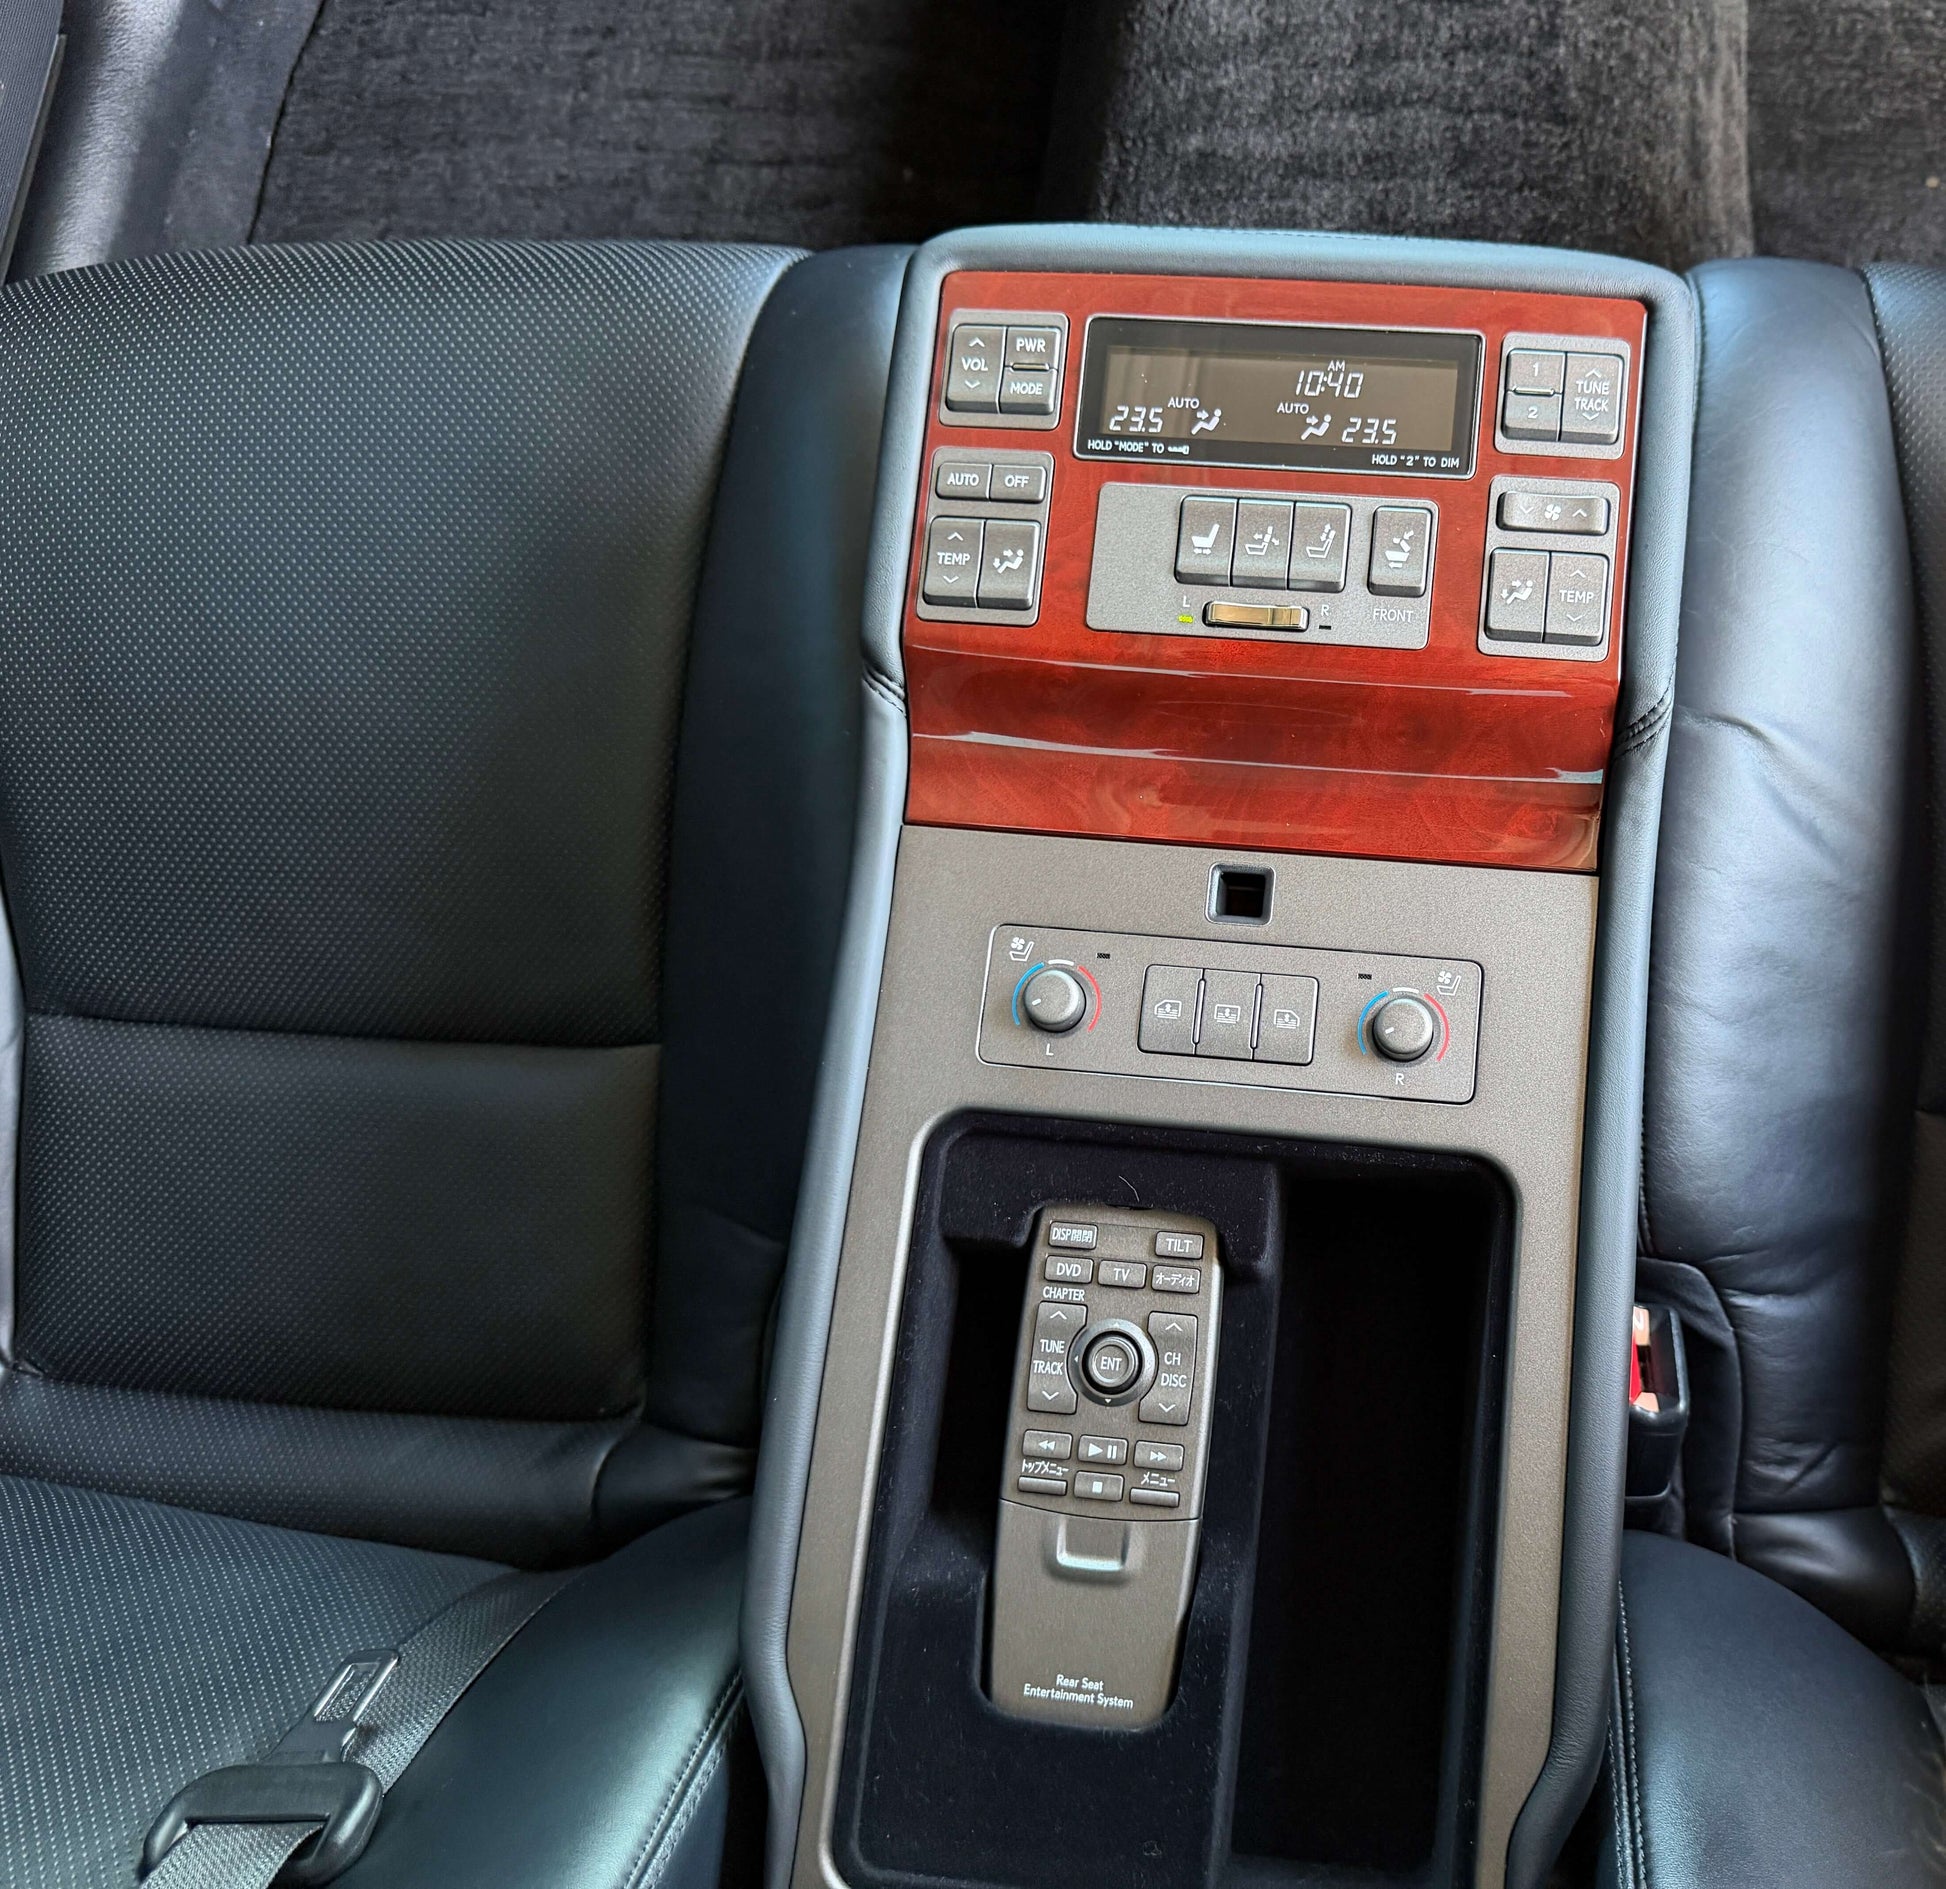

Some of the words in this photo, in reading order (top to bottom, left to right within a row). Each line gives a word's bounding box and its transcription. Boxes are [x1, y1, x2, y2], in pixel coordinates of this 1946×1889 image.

[1016, 338, 1046, 353] PWR
[961, 358, 989, 372] VOL
[1327, 360, 1346, 372] AM
[1532, 363, 1540, 377] 1
[1010, 382, 1044, 395] MODE
[1295, 370, 1364, 399] 10:40
[1576, 380, 1610, 395] TUNE
[1167, 397, 1200, 409] AUTO
[1277, 403, 1310, 415] AUTO
[1574, 398, 1609, 412] TRACK
[1109, 405, 1163, 434] 23.5
[1526, 406, 1539, 419] 2
[1341, 417, 1397, 445] 23.5
[1087, 439, 1113, 452] HOLD
[1151, 443, 1165, 455] TO
[1371, 454, 1398, 466] HOLD
[1422, 456, 1437, 468] TO
[1440, 457, 1460, 469] DIM
[947, 473, 979, 487] AUTO
[1004, 475, 1030, 488] OFF
[937, 552, 971, 566] TEMP
[1182, 595, 1190, 607] L
[1559, 589, 1595, 604] TEMP
[1321, 604, 1331, 617] R
[1372, 608, 1414, 623] FRONT
[1045, 1042, 1055, 1056] L
[1395, 1072, 1406, 1086] R
[1166, 1238, 1193, 1253] TILT
[1056, 1263, 1082, 1277] DVD
[1113, 1268, 1131, 1282] TV
[1155, 1272, 1195, 1287] オーディオ
[1042, 1286, 1085, 1302] CHAPTER
[1040, 1339, 1065, 1354] TUNE
[1100, 1357, 1122, 1371] ENT
[1164, 1351, 1181, 1366] CH
[1033, 1360, 1063, 1376] TRACK
[1161, 1373, 1187, 1388] DISC
[1021, 1459, 1069, 1475] トップメニュー
[1140, 1472, 1176, 1487] メニュー
[1056, 1673, 1080, 1689] Rear
[1081, 1677, 1104, 1691] Seat
[1023, 1683, 1095, 1704] Entertainment
[1097, 1692, 1134, 1710] System
